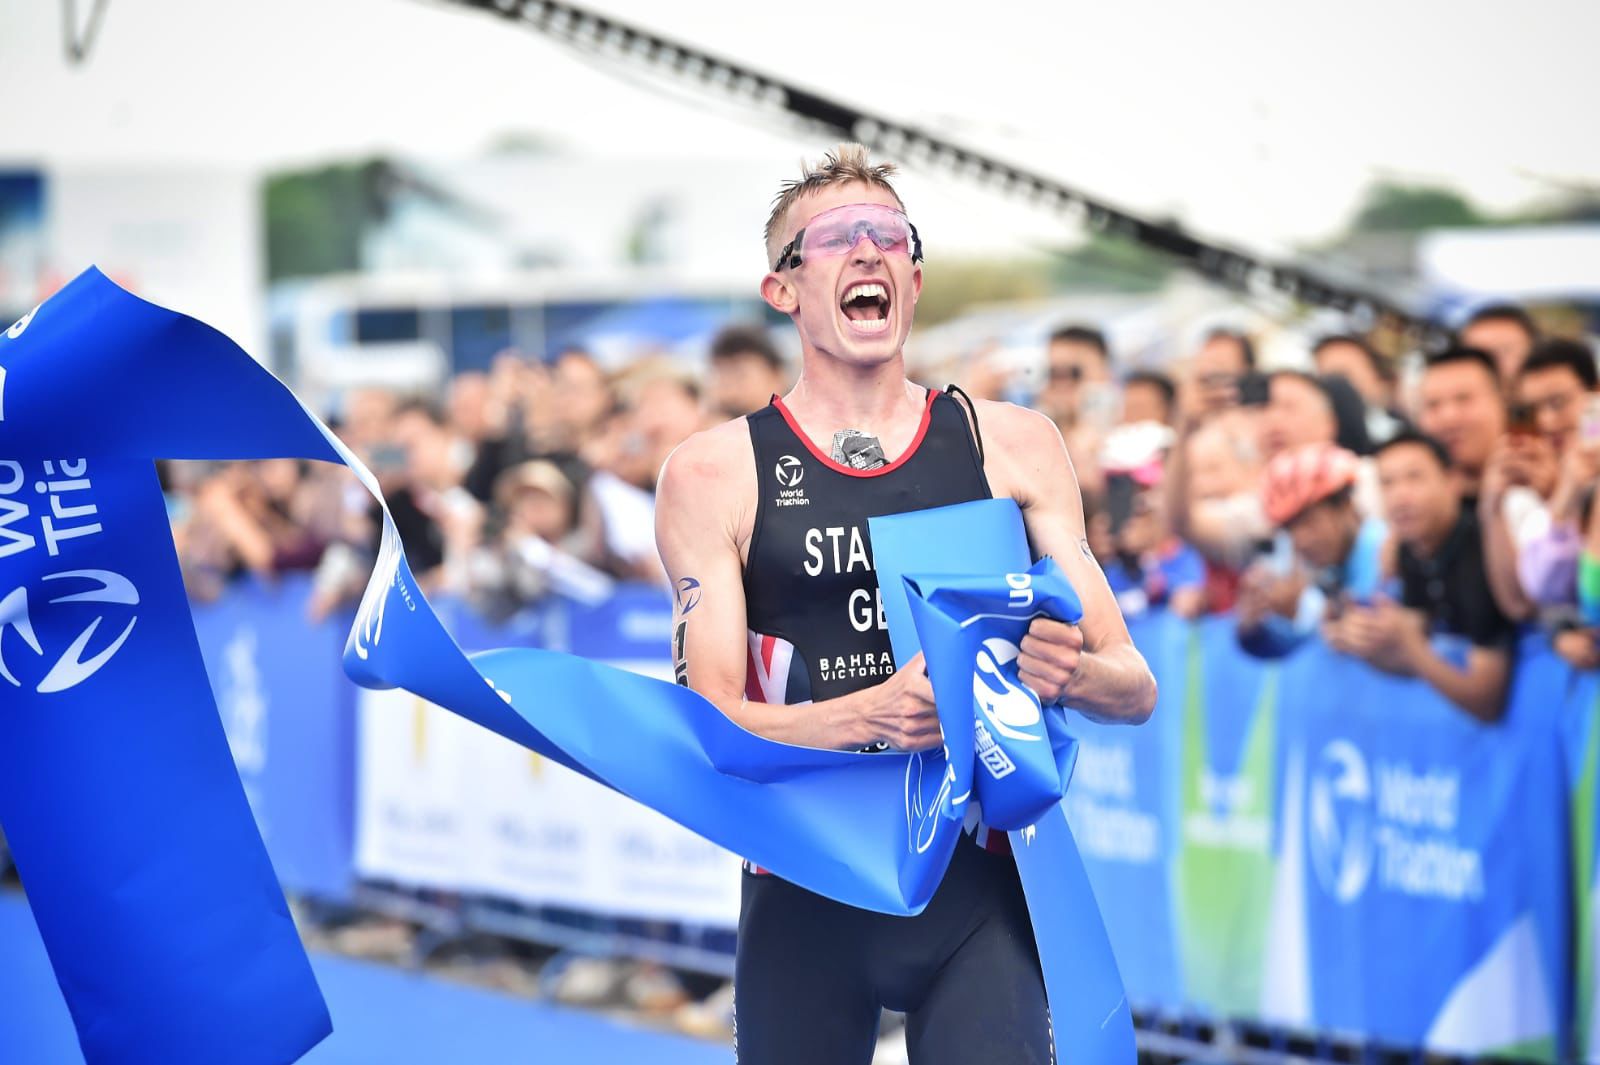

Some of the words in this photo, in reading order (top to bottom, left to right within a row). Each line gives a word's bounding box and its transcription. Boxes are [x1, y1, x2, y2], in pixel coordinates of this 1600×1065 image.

[775, 496, 810, 507] Triathlon
[780, 489, 804, 498] World
[803, 526, 877, 577] STA
[819, 652, 892, 671] BAHRA
[820, 665, 894, 682] VICTORIO
